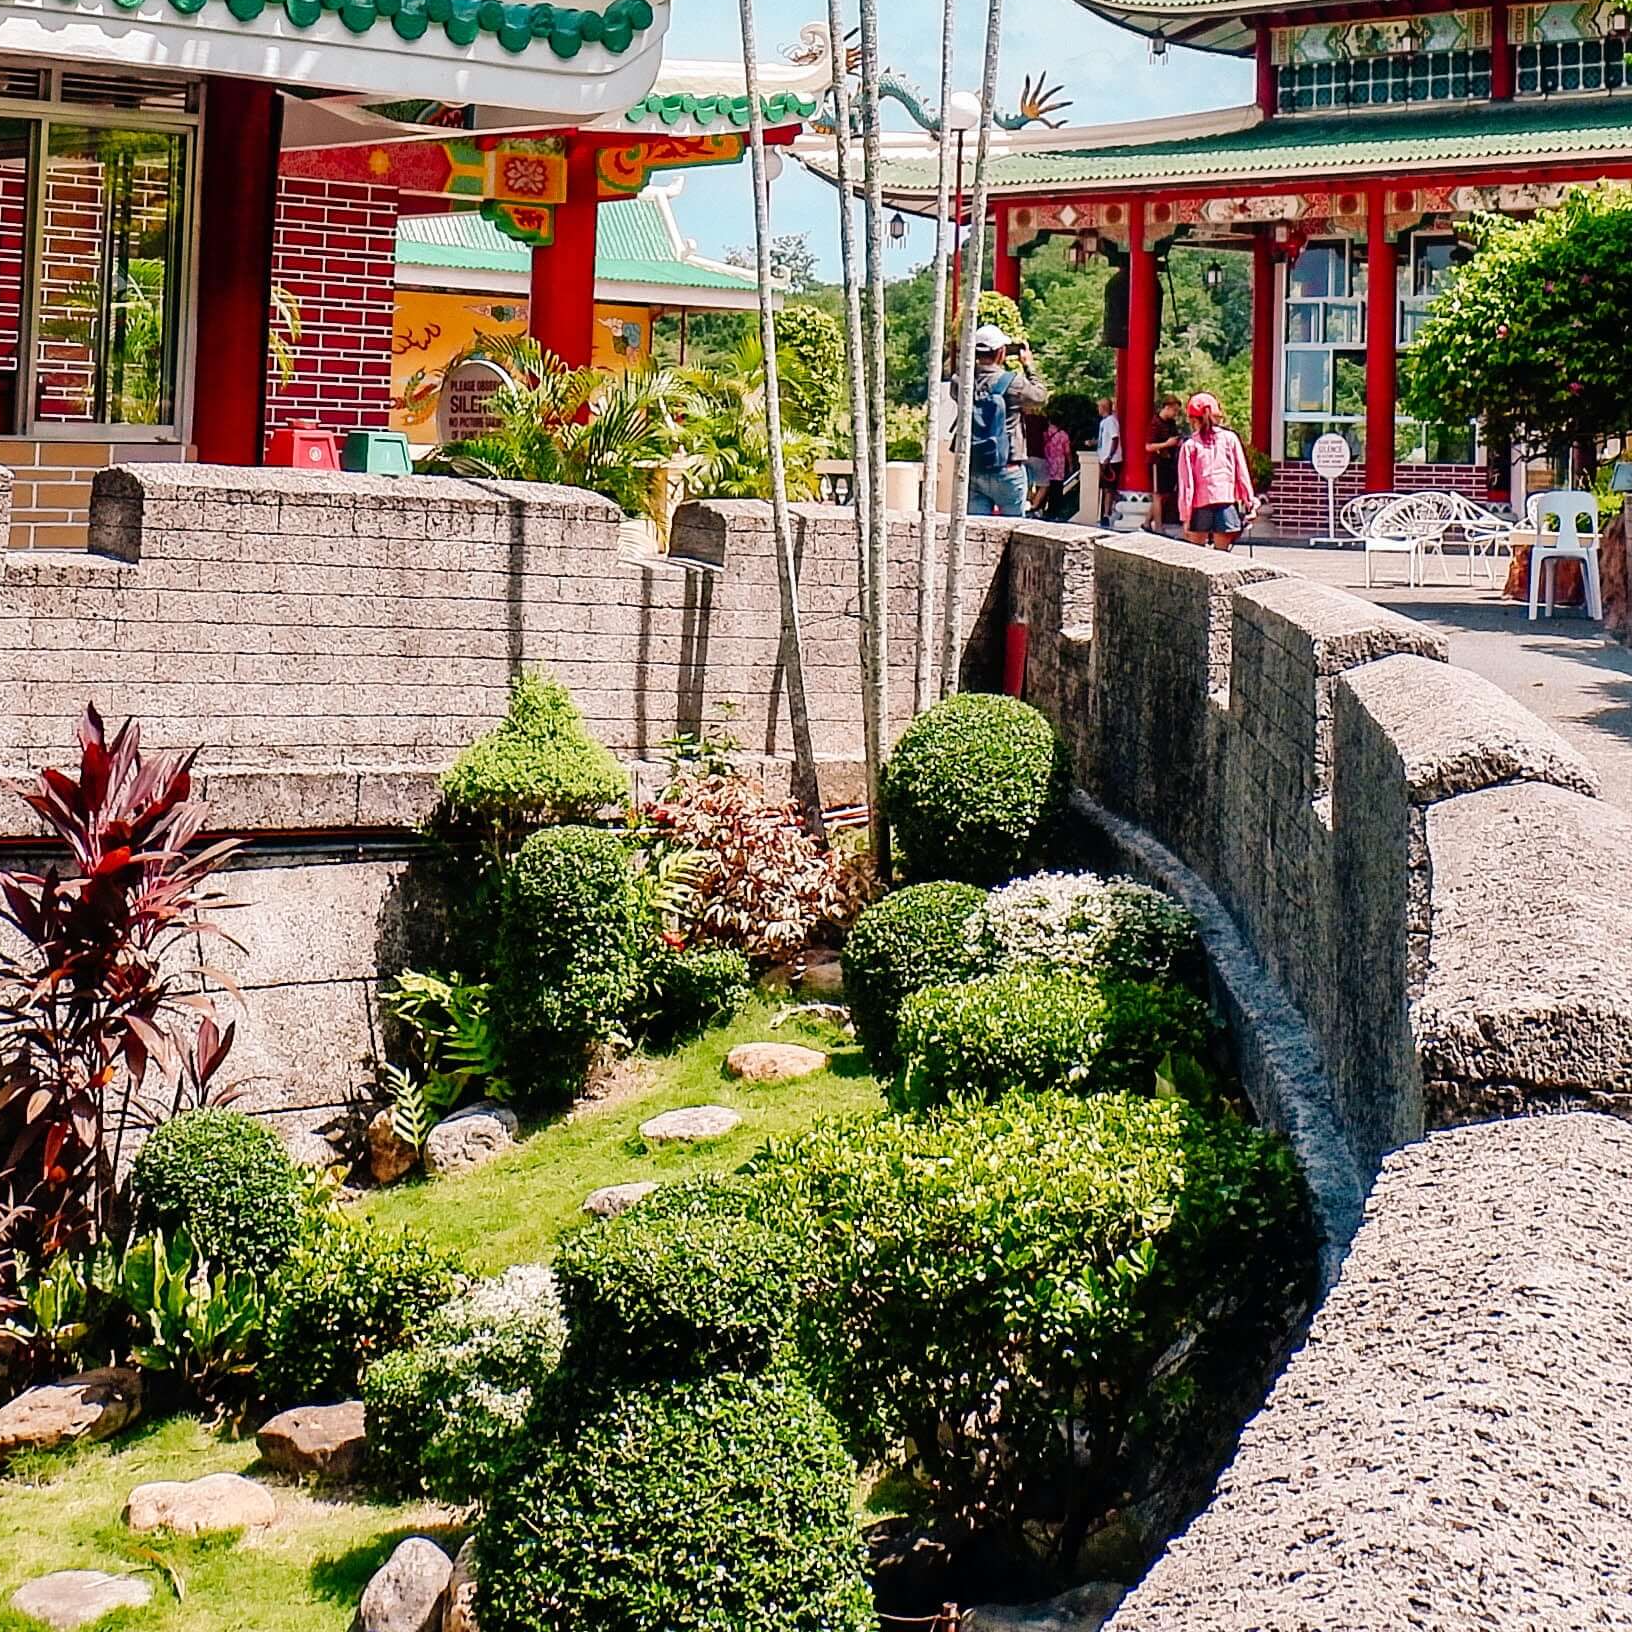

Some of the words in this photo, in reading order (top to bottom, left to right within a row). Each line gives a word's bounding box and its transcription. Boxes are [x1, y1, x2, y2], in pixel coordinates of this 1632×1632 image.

[451, 380, 475, 391] PLEASE
[477, 380, 498, 391] OBSER
[450, 395, 496, 414] SILEN
[449, 417, 458, 427] NO
